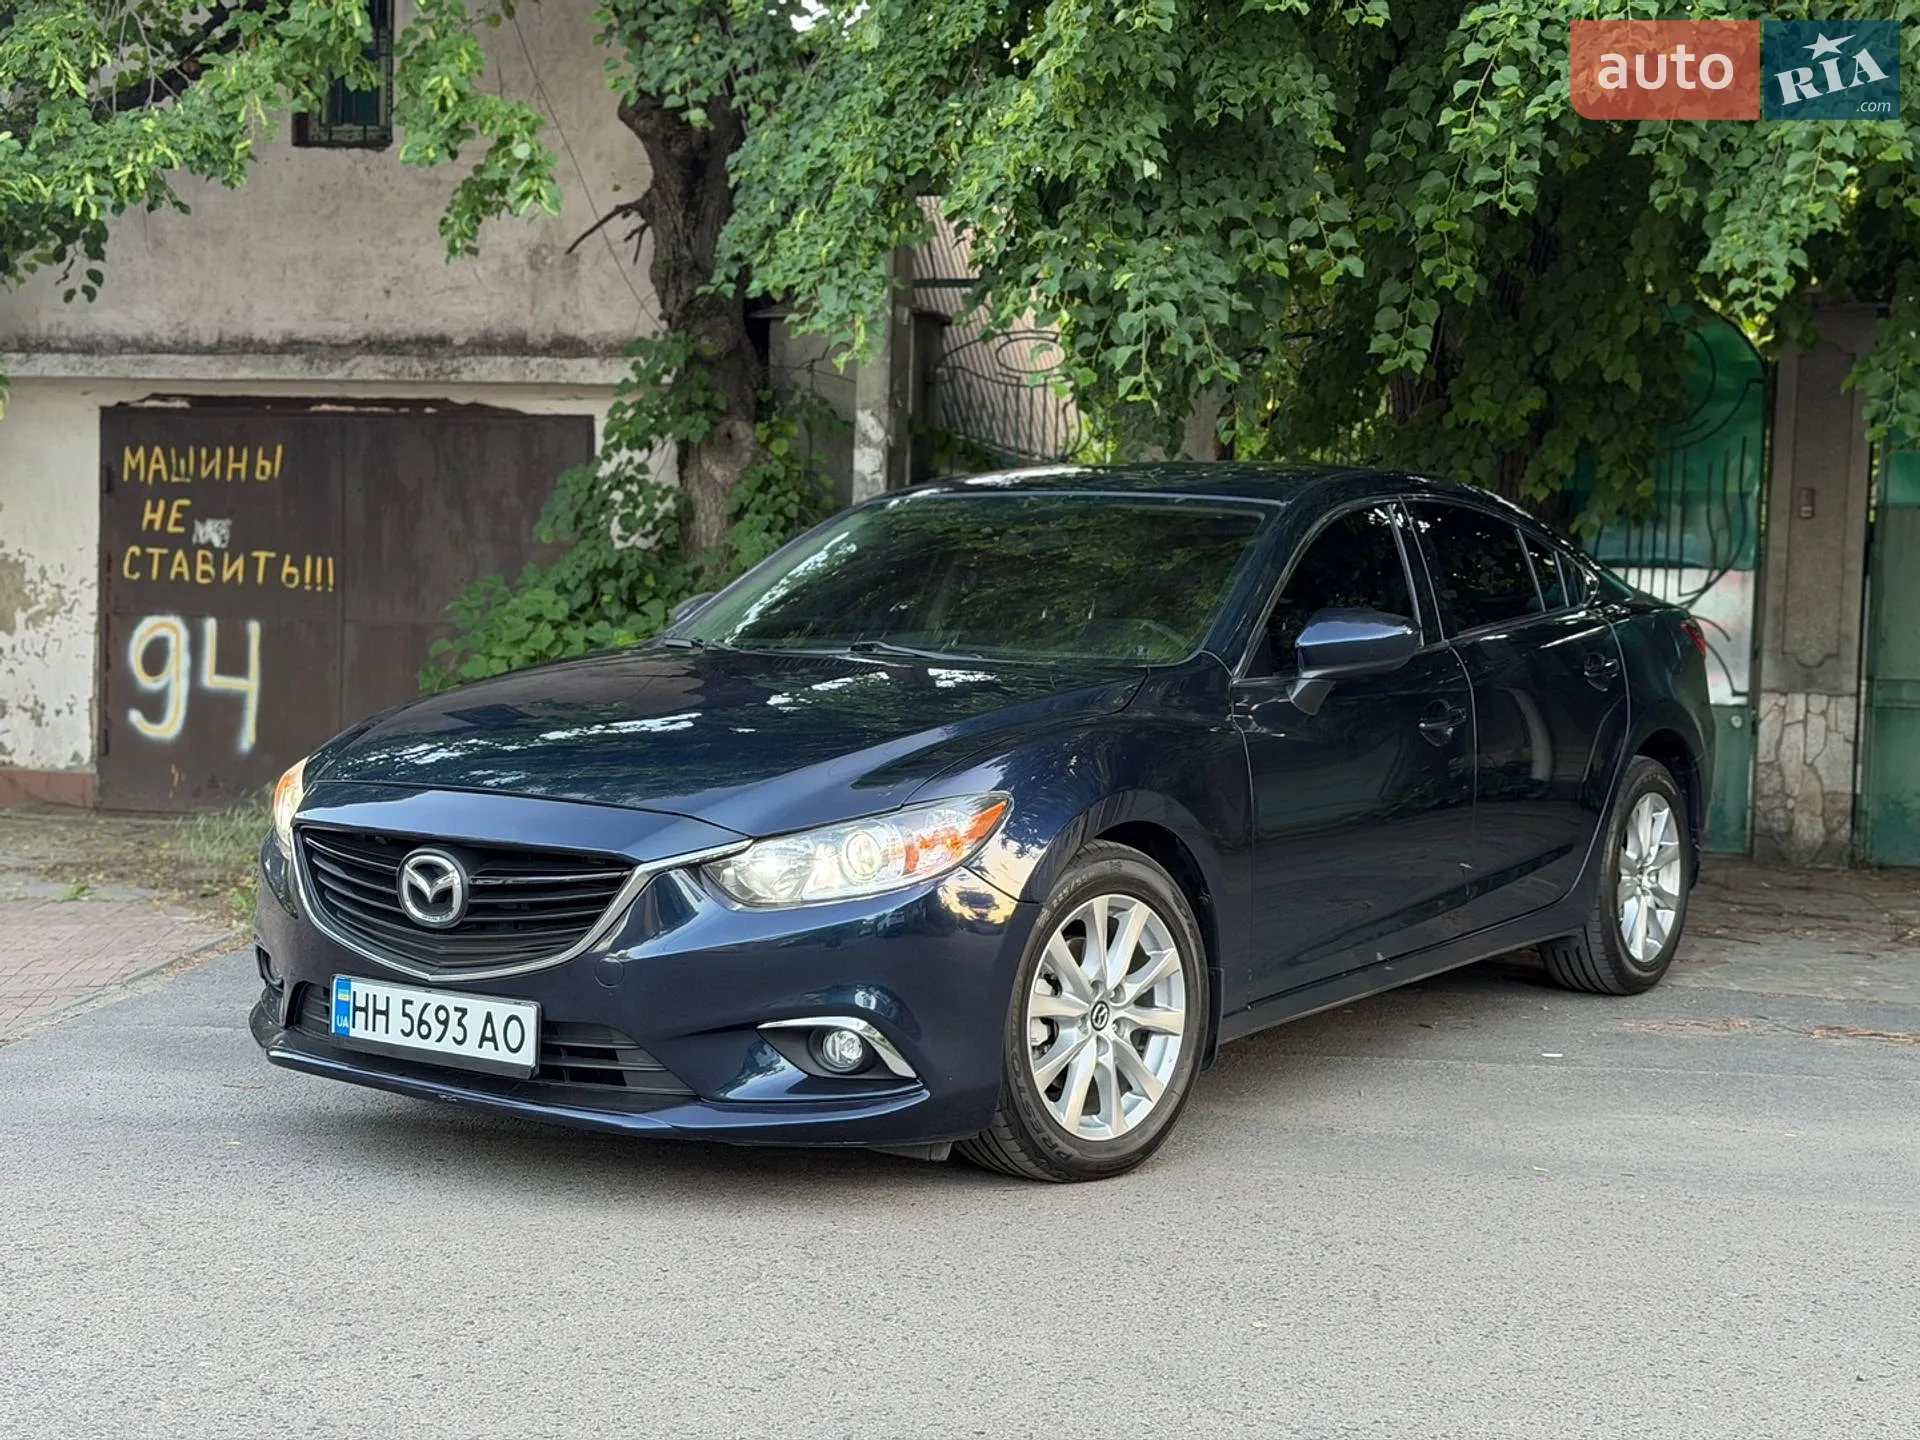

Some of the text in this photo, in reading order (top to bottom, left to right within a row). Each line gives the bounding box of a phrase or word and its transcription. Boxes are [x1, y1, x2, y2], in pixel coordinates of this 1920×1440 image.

[122, 444, 284, 486] МАШИНЫ
[142, 498, 192, 533] НЕ
[122, 545, 336, 592] СТАВИТЬ!!!
[128, 615, 262, 753] 94
[336, 1015, 349, 1028] UA
[352, 990, 526, 1053] HH 5693 AO
